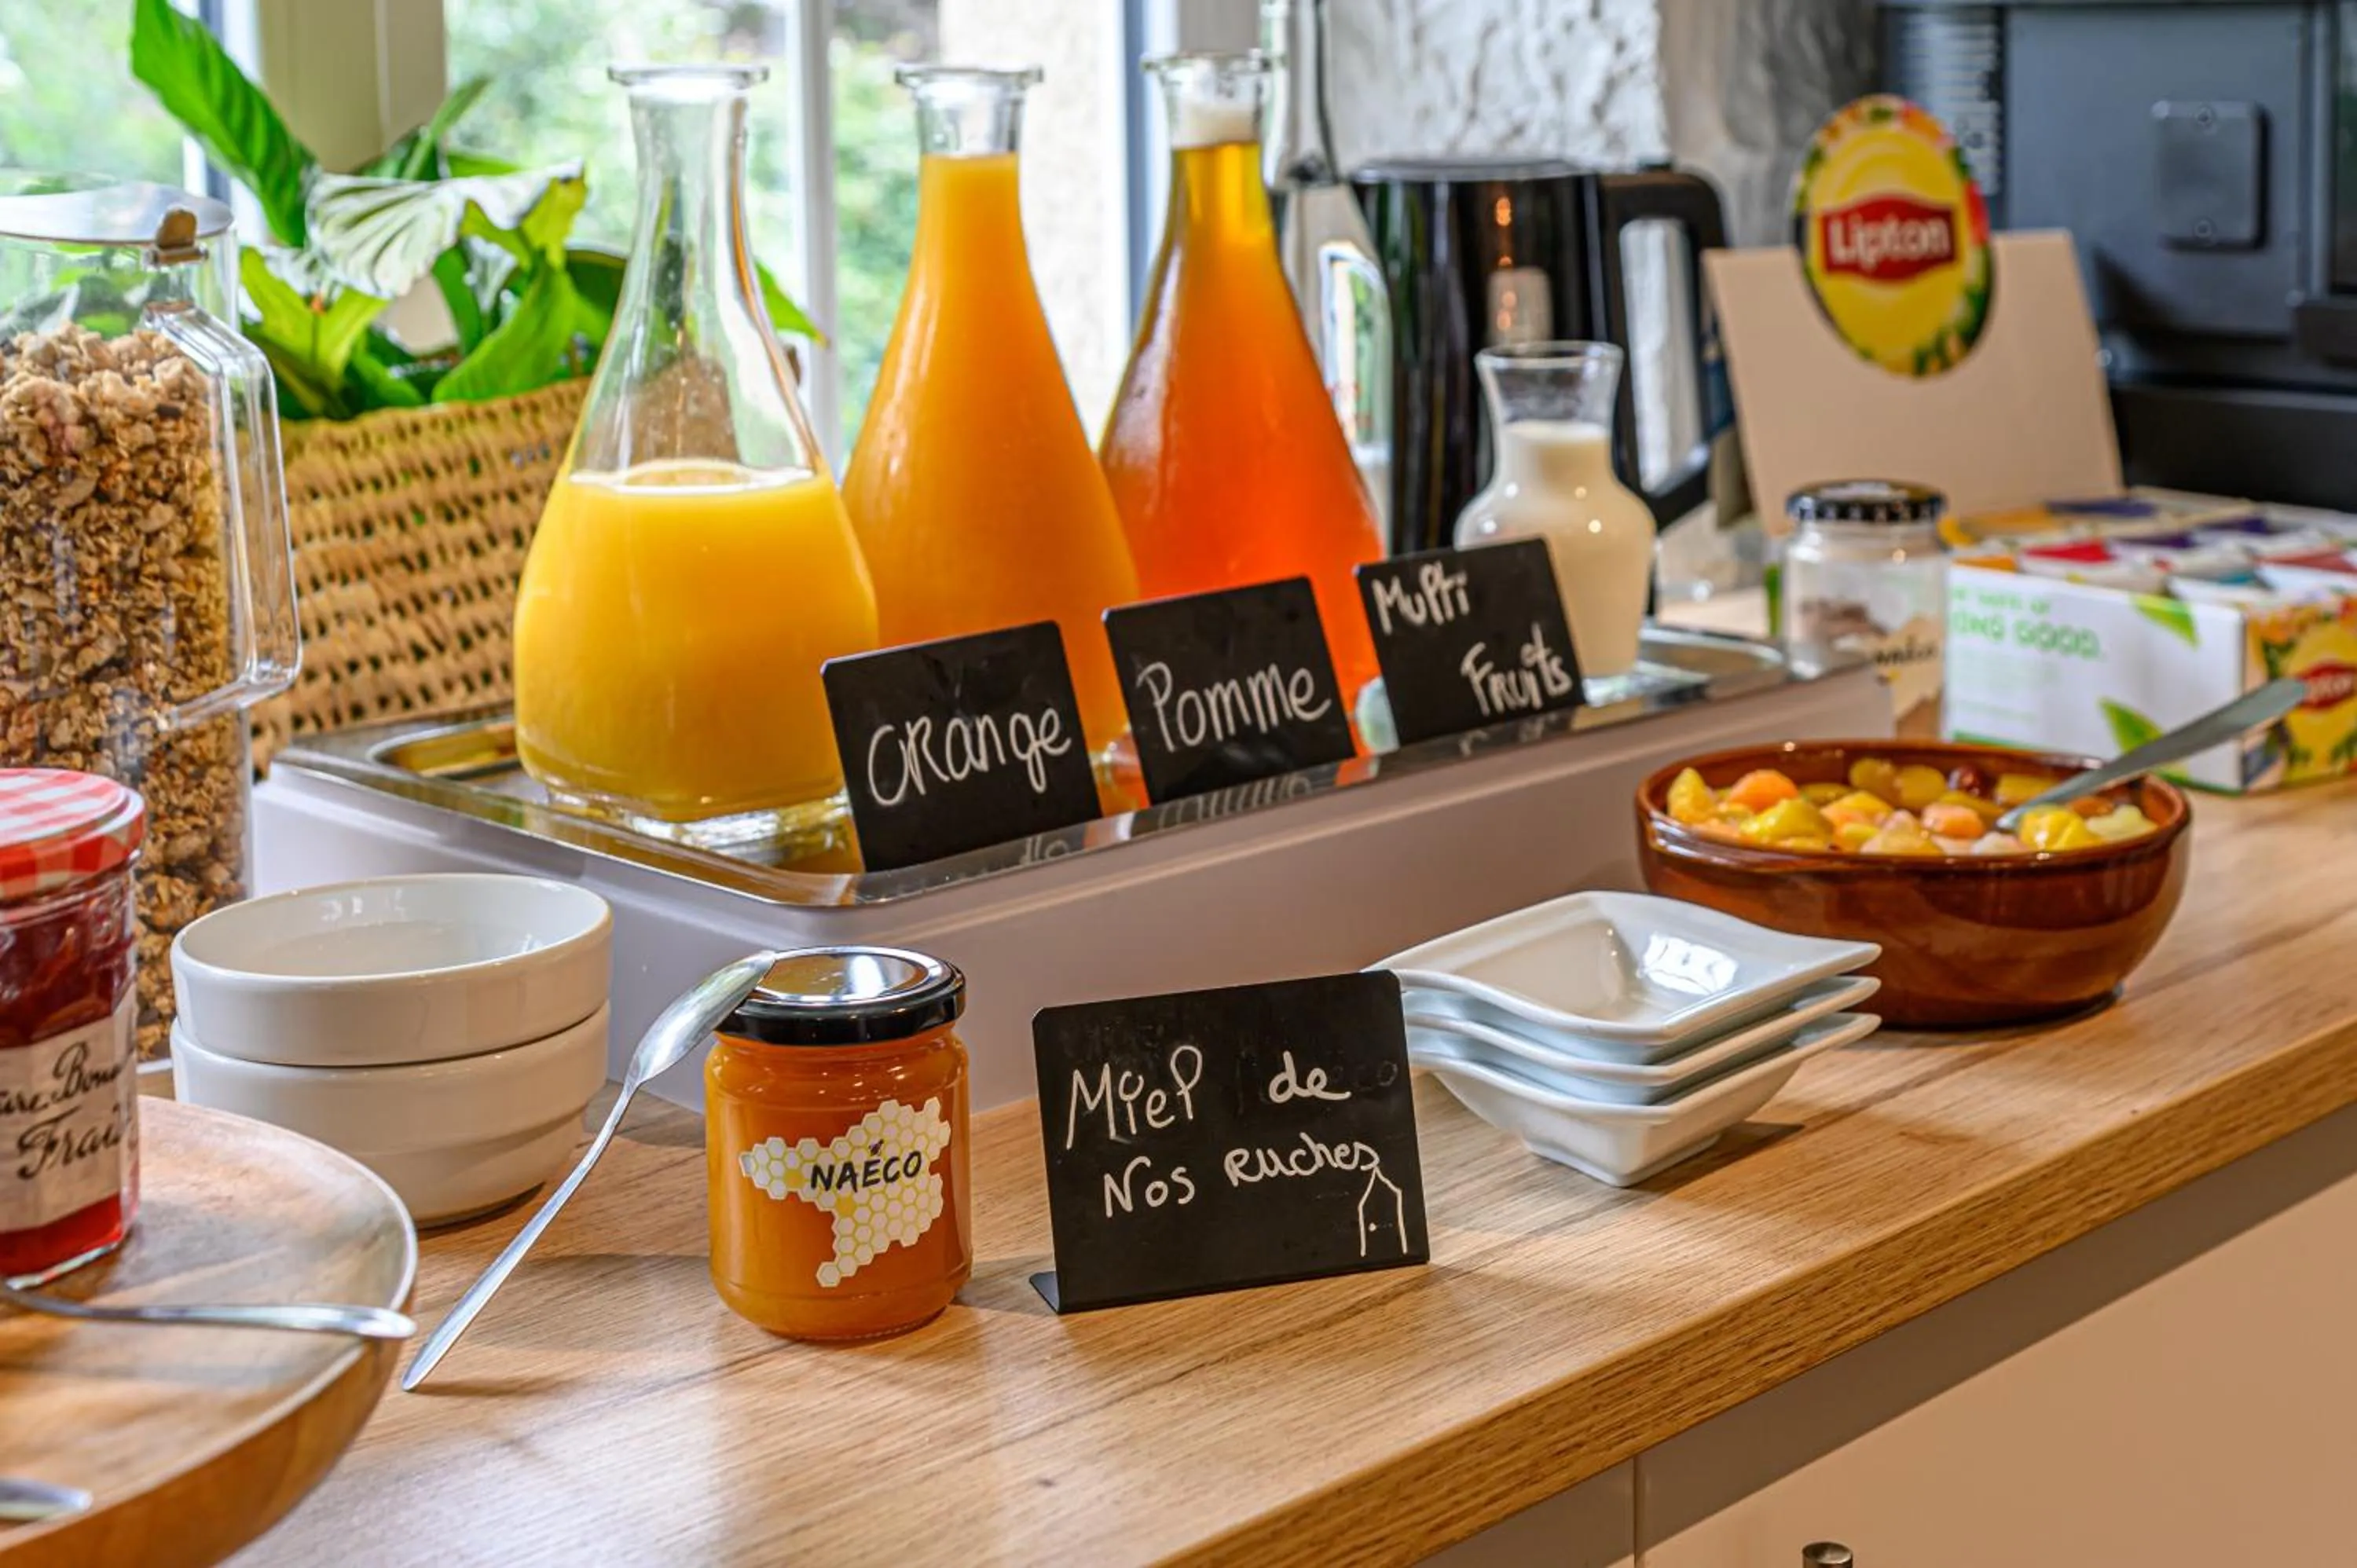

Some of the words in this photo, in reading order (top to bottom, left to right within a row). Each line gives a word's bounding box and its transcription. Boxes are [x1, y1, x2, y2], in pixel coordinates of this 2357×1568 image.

[1828, 211, 1951, 271] Lipton
[1136, 661, 1332, 753] Pomme
[1065, 1044, 1204, 1150] Miel
[1268, 1050, 1351, 1104] de
[810, 1139, 922, 1193] NAÉCO
[1103, 1156, 1196, 1218] Nos
